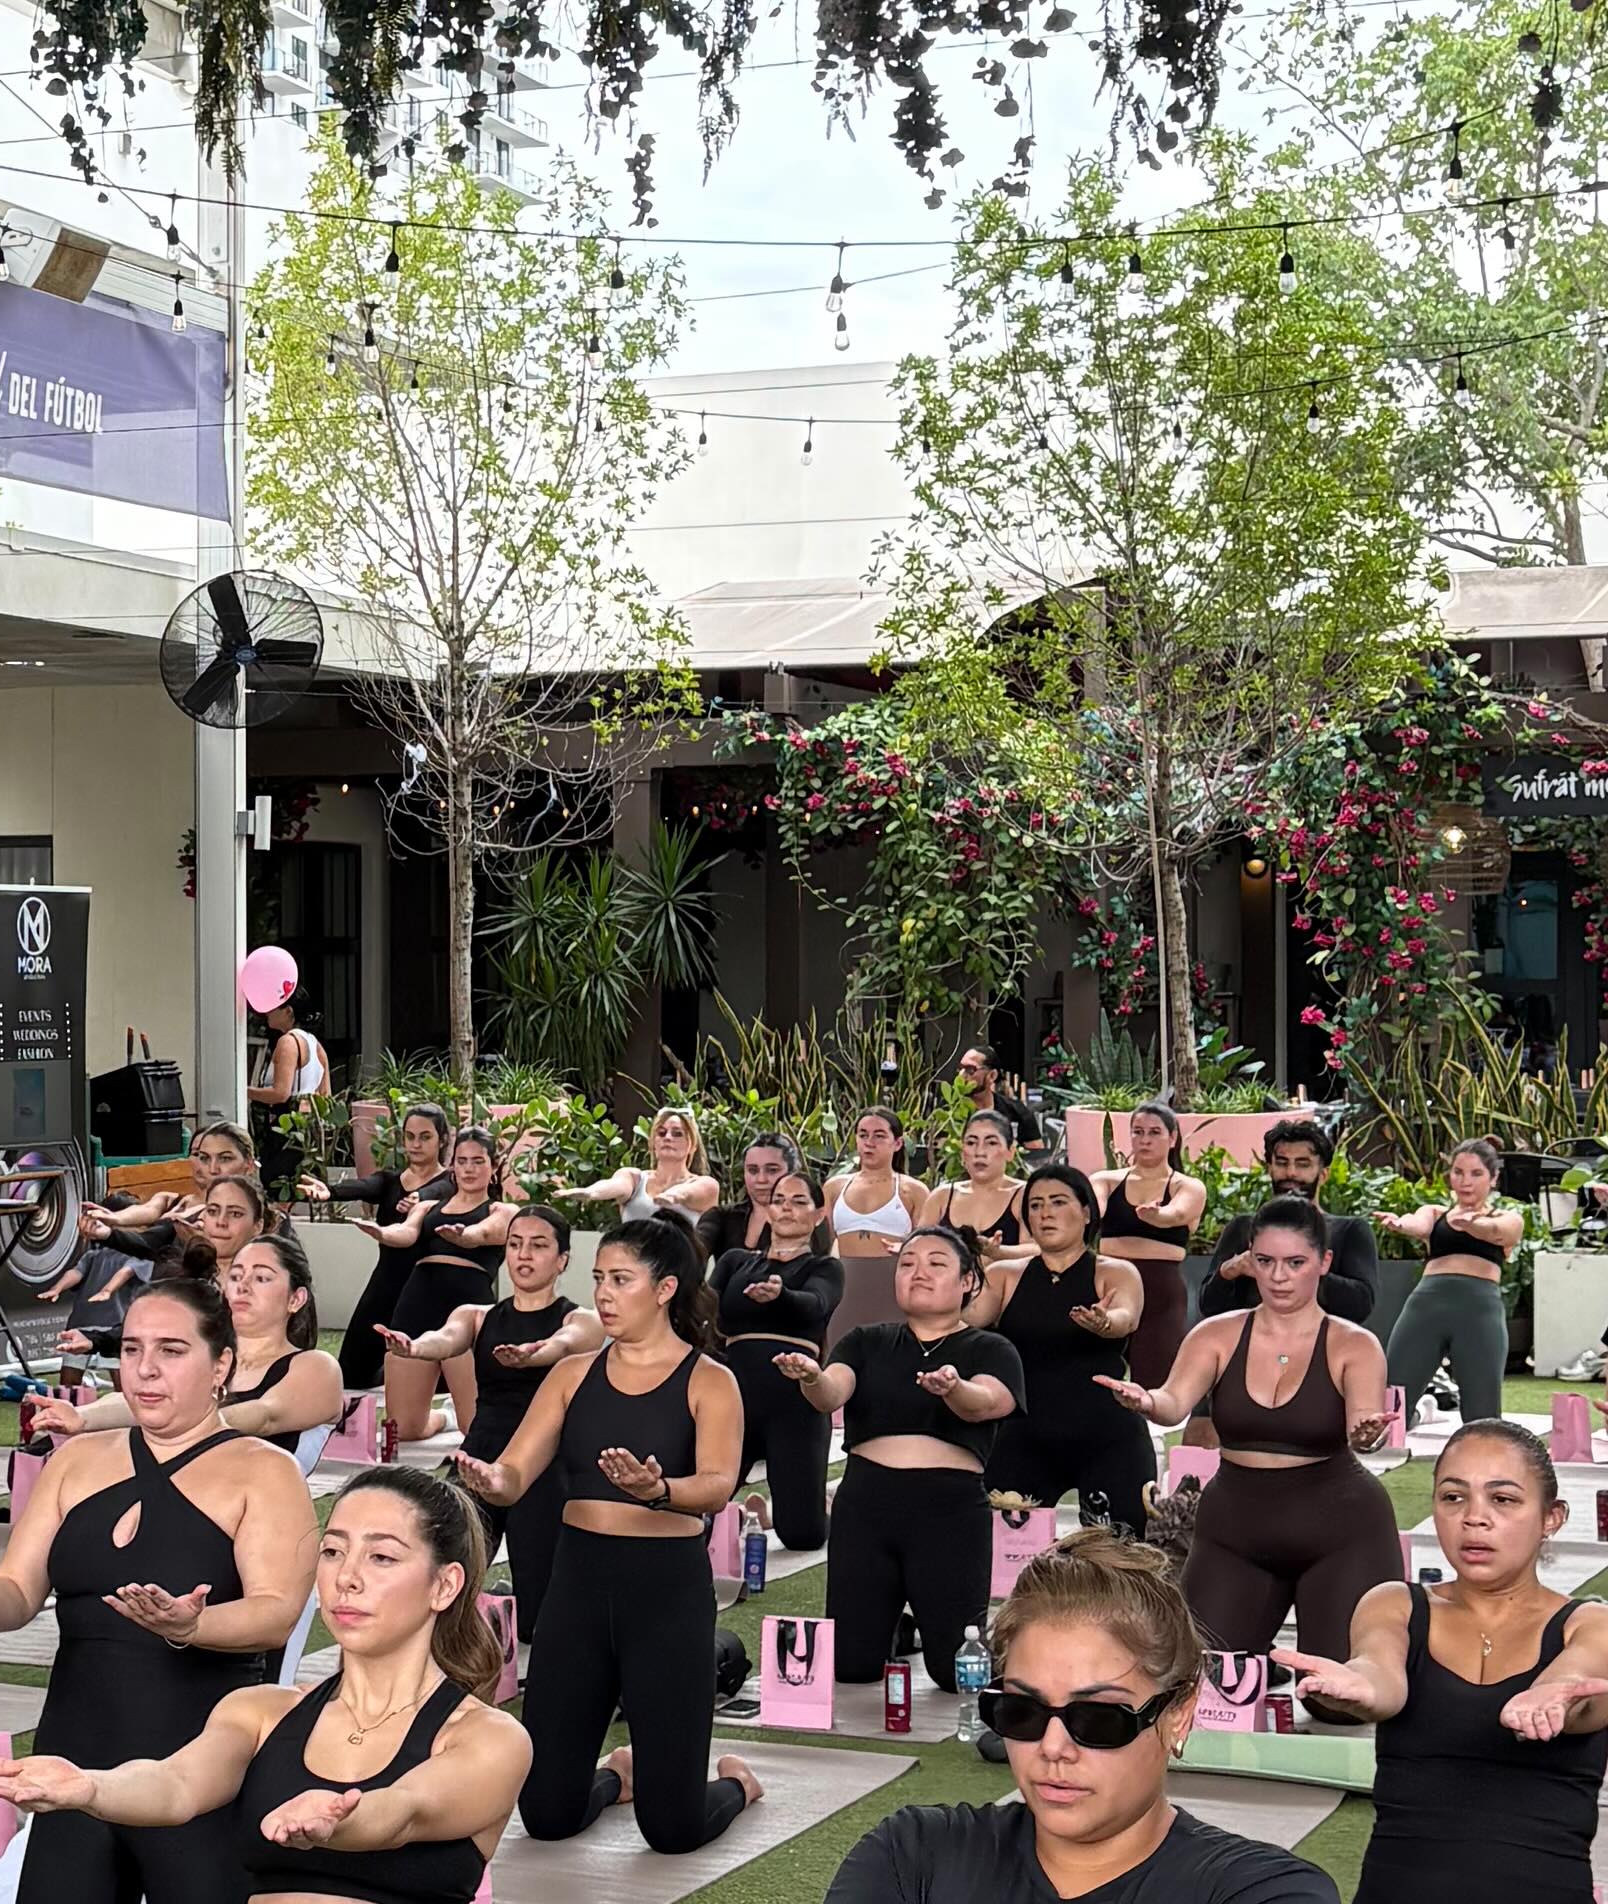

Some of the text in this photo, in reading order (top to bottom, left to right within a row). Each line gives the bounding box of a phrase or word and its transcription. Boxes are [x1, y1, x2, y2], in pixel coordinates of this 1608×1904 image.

[8, 372, 38, 420] DEL
[44, 376, 103, 435] FÚTBOL
[17, 956, 52, 974] MORA
